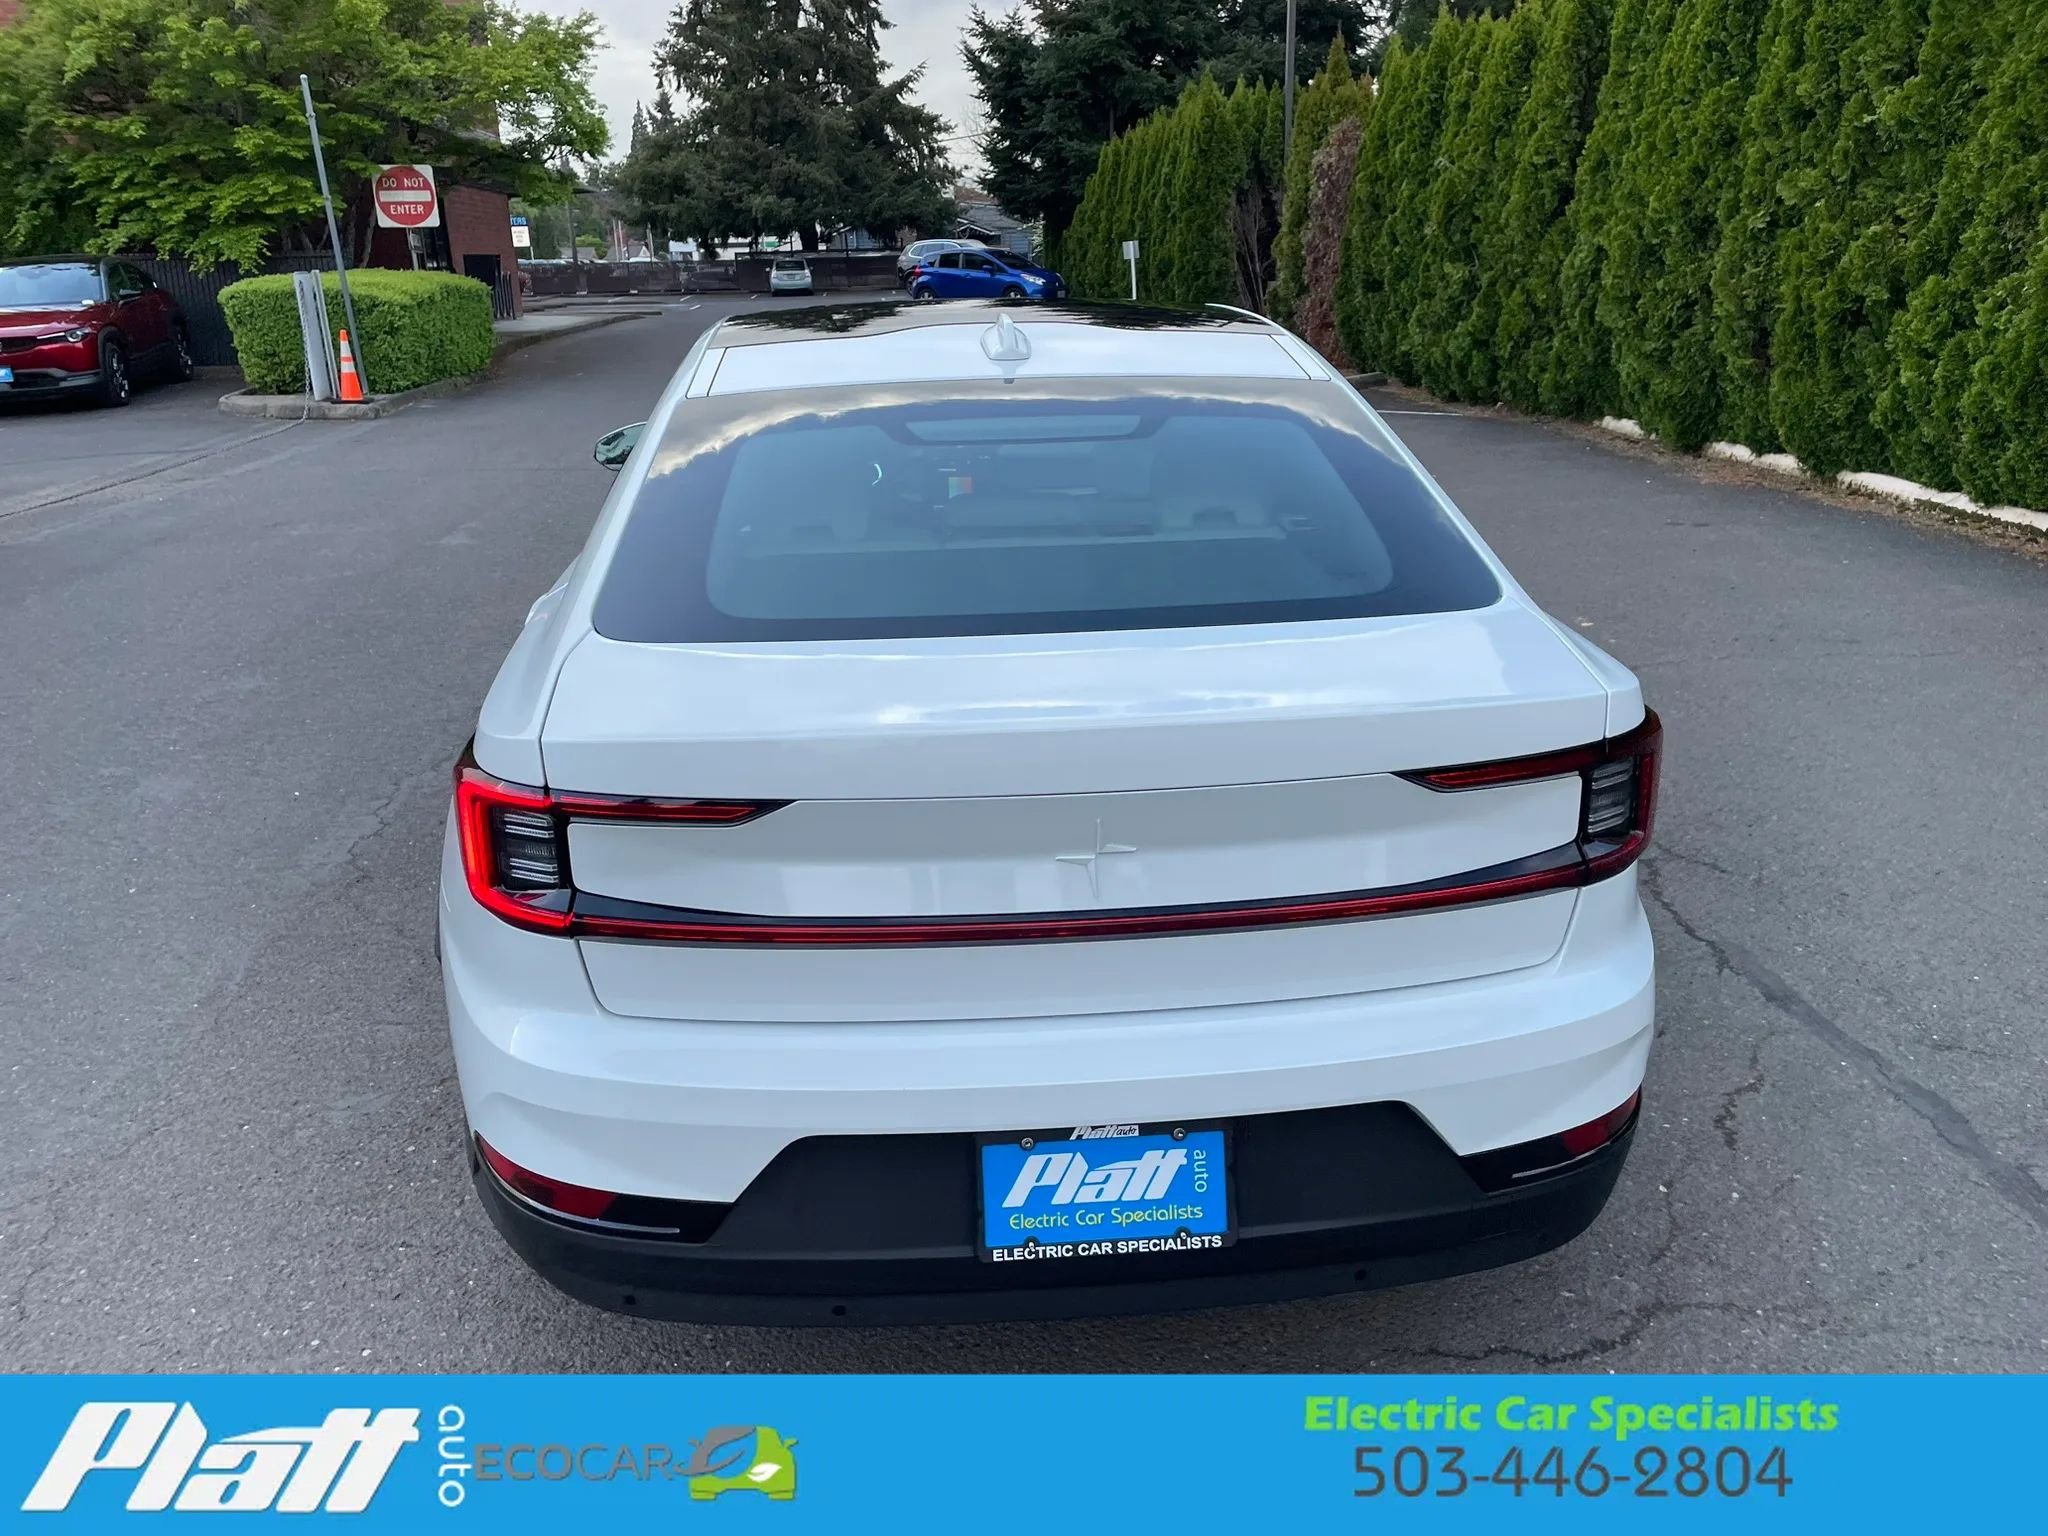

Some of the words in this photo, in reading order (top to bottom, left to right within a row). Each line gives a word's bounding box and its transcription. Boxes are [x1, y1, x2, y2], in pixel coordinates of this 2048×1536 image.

[382, 177, 397, 188] DO
[404, 177, 424, 188] NOT
[390, 204, 425, 215] ENTER
[1002, 1149, 1187, 1208] Platt
[1193, 1150, 1208, 1193] auto
[1009, 1211, 1070, 1230] Electric
[1075, 1208, 1104, 1225] Car
[1111, 1205, 1203, 1227] Specialists
[992, 1244, 1074, 1262] ELECTRIC
[1077, 1241, 1113, 1256] CAR
[1117, 1234, 1222, 1253] SPECIALISTS
